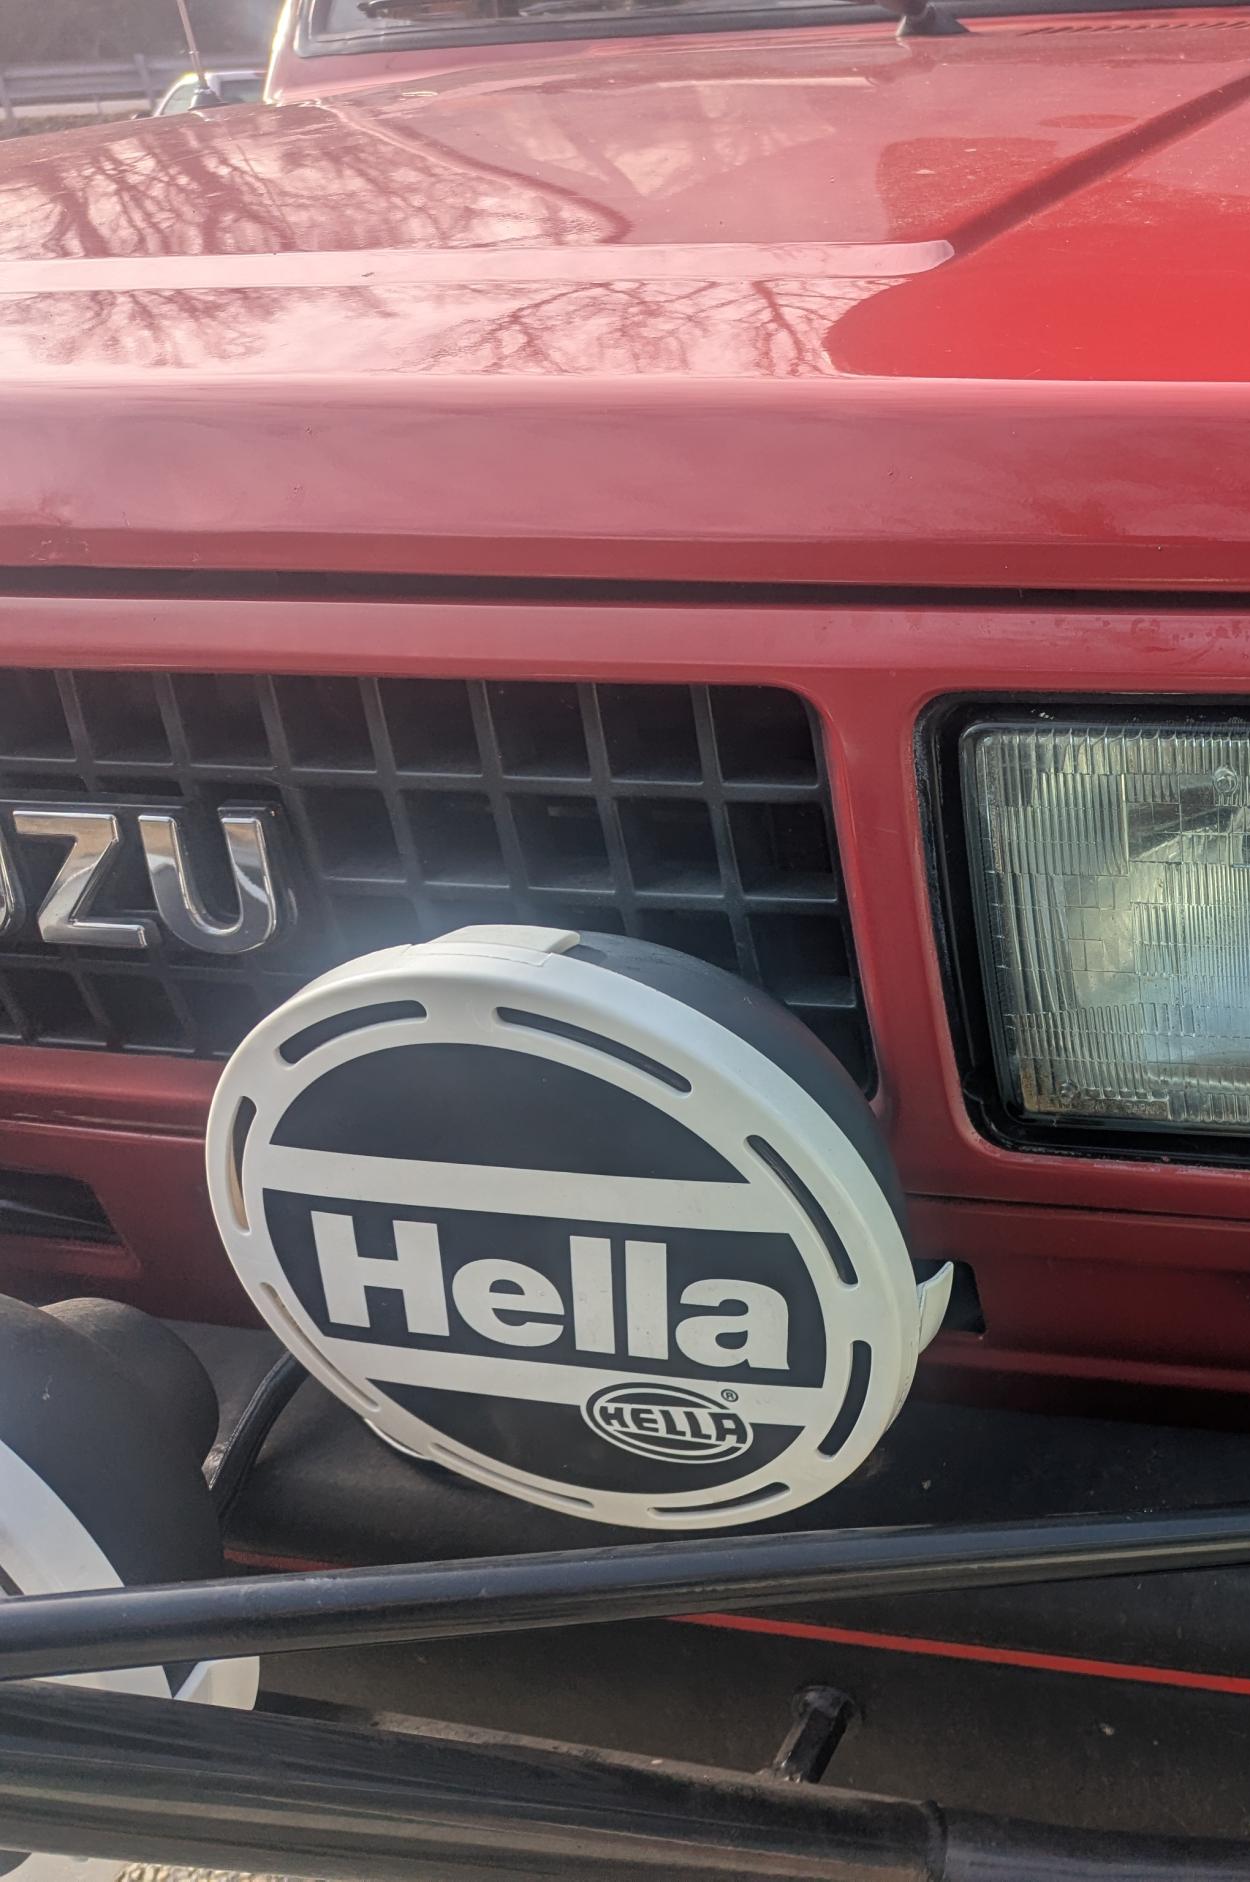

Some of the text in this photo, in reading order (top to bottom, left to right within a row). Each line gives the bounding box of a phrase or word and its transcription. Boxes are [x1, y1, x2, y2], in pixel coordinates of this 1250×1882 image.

[0, 809, 278, 955] ZU
[310, 1210, 790, 1370] Hella
[599, 1405, 748, 1445] HELLA
